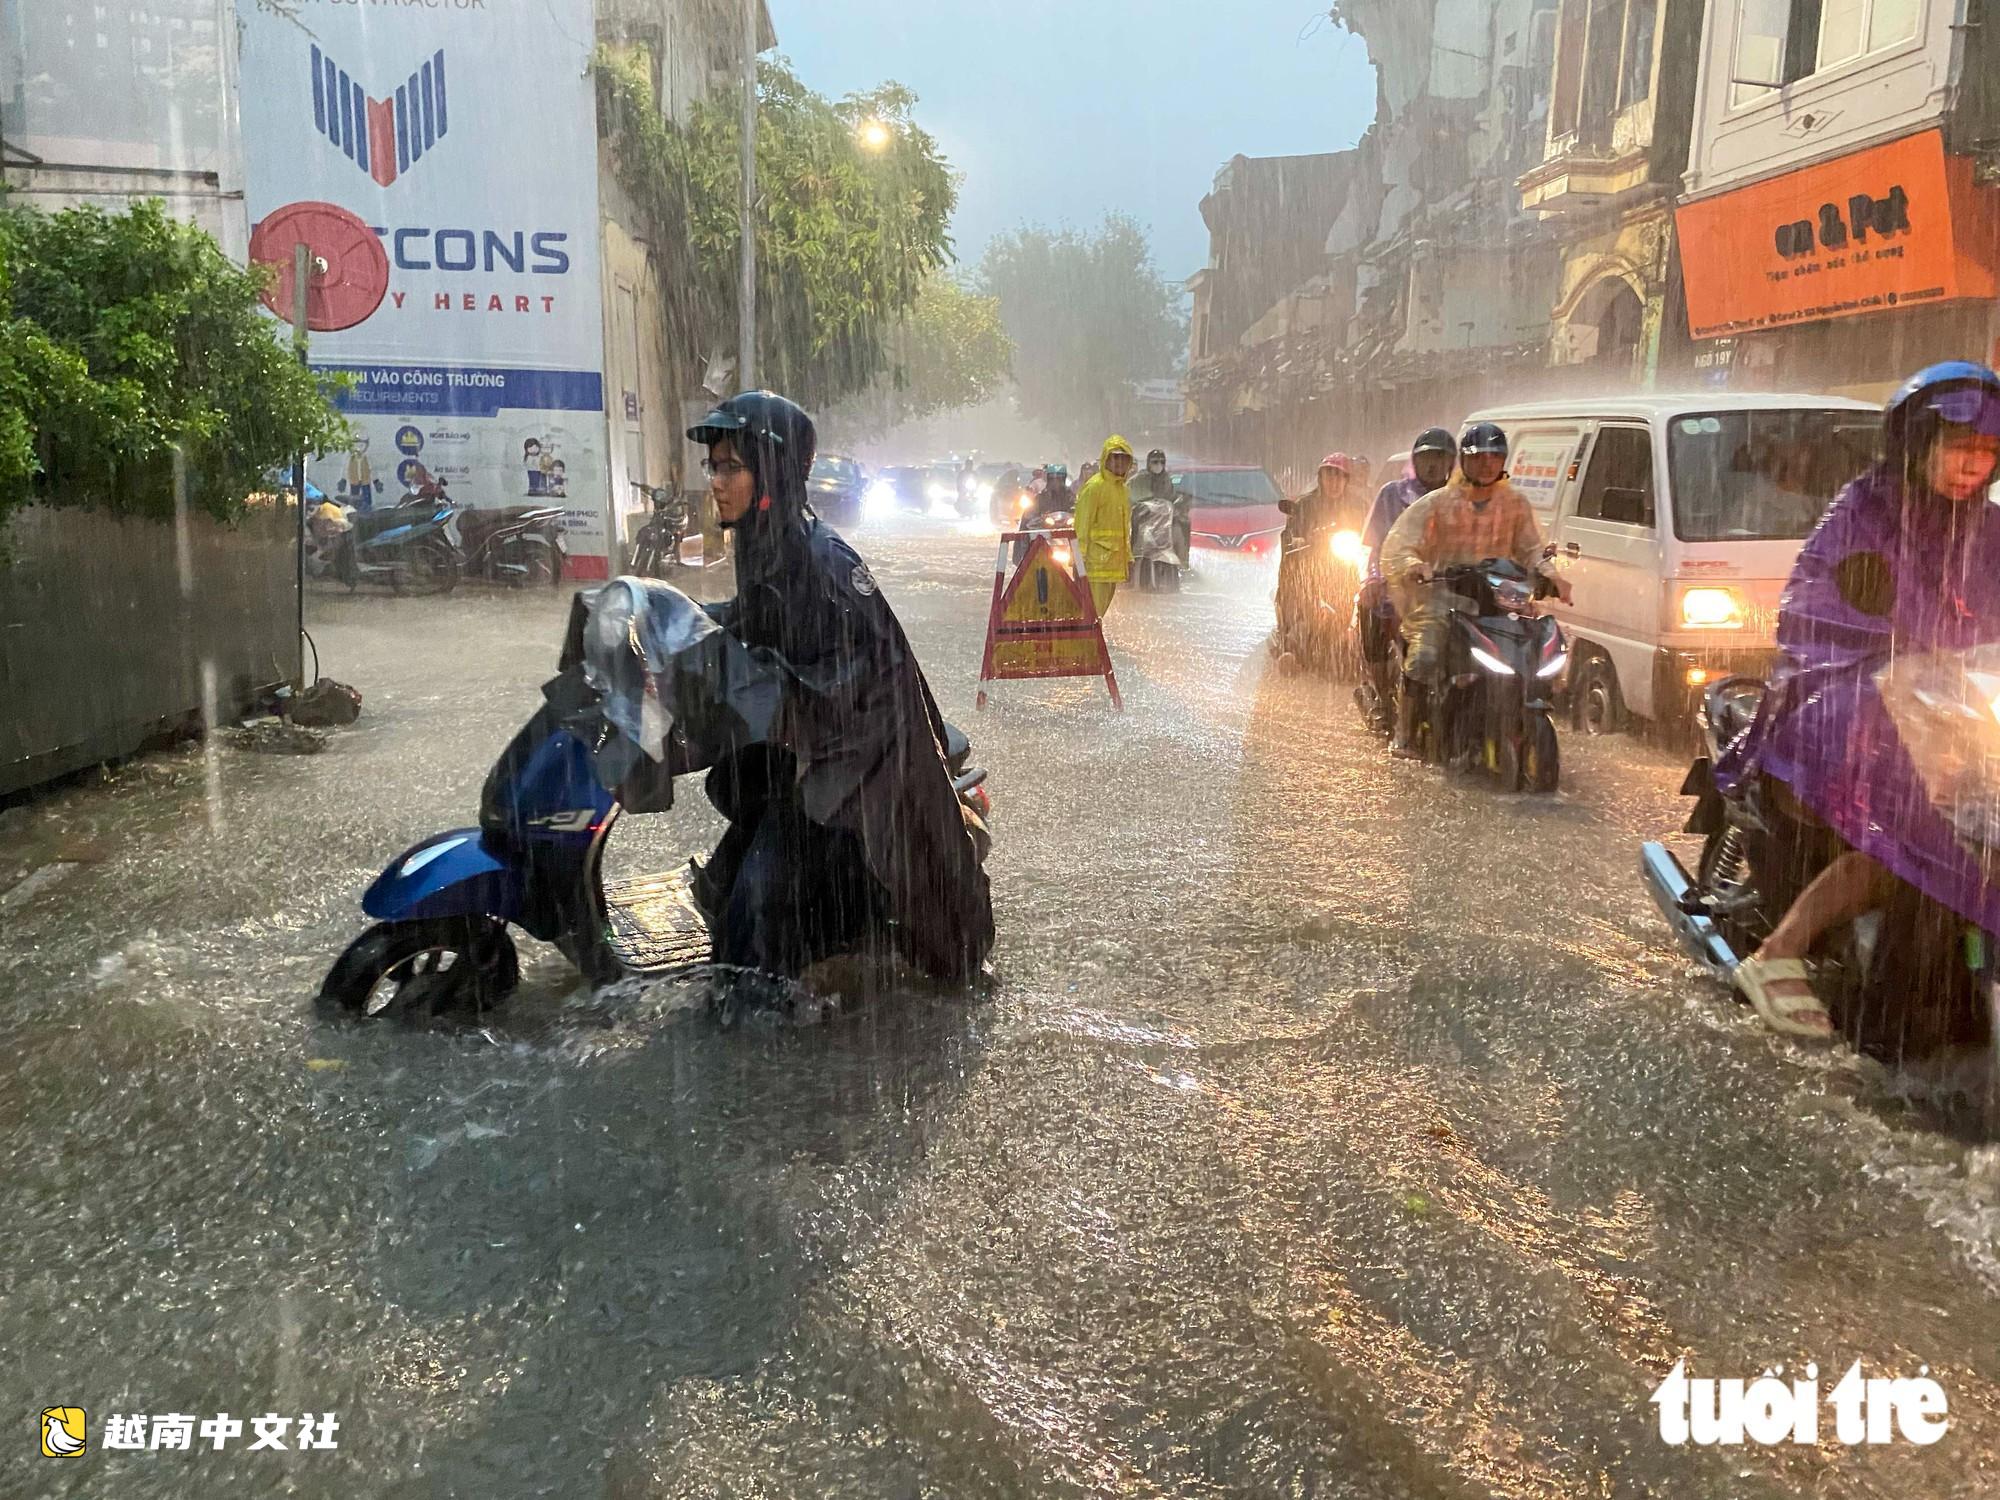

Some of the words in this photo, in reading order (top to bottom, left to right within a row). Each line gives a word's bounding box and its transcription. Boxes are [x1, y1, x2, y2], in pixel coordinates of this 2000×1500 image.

[371, 227, 569, 274] CONS
[434, 293, 554, 313] HEART
[371, 369, 400, 385] VÀO
[403, 370, 443, 386] CÔNG
[446, 371, 505, 388] TRƯỜNG
